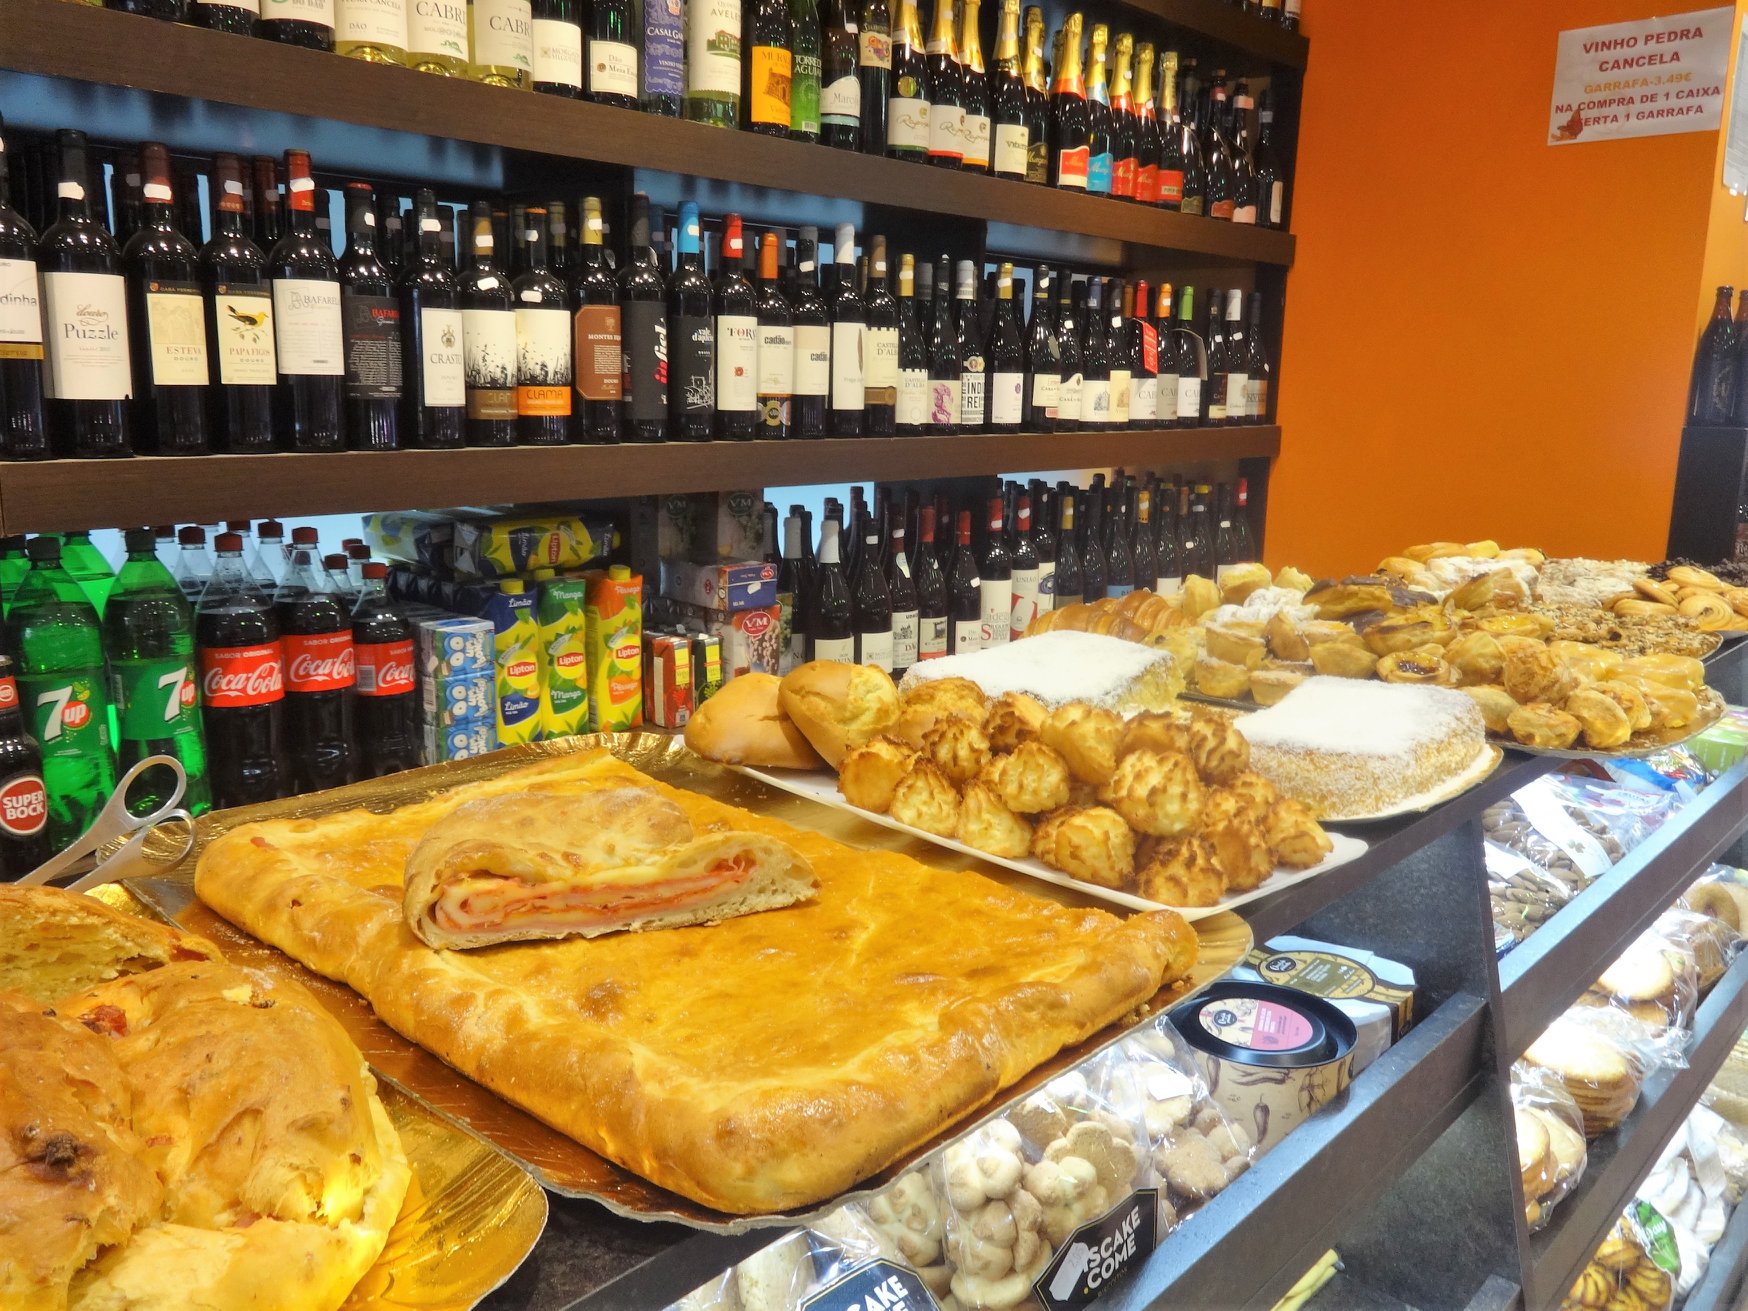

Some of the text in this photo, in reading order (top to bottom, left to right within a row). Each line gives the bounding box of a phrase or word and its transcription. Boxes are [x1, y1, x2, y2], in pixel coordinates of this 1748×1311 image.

[1582, 26, 1704, 54] VINHO PEDRA
[1598, 51, 1681, 72] CANCELA
[1554, 85, 1721, 114] NA COMPRA DE 1 CAIXA
[1624, 111, 1631, 121] 1
[1636, 104, 1704, 121] GARRAFA
[64, 323, 119, 340] Puzzle
[508, 598, 532, 607] Limão
[553, 590, 583, 600] Manga
[559, 654, 583, 666] Lipton
[617, 647, 640, 658] Lipton
[509, 664, 535, 676] Lipton
[204, 661, 283, 697] Coca-Cola
[551, 690, 582, 700] Manga
[504, 701, 529, 711] Limão
[3, 791, 44, 809] SUPER
[6, 803, 45, 820] BOCK
[1087, 1233, 1137, 1289] COME
